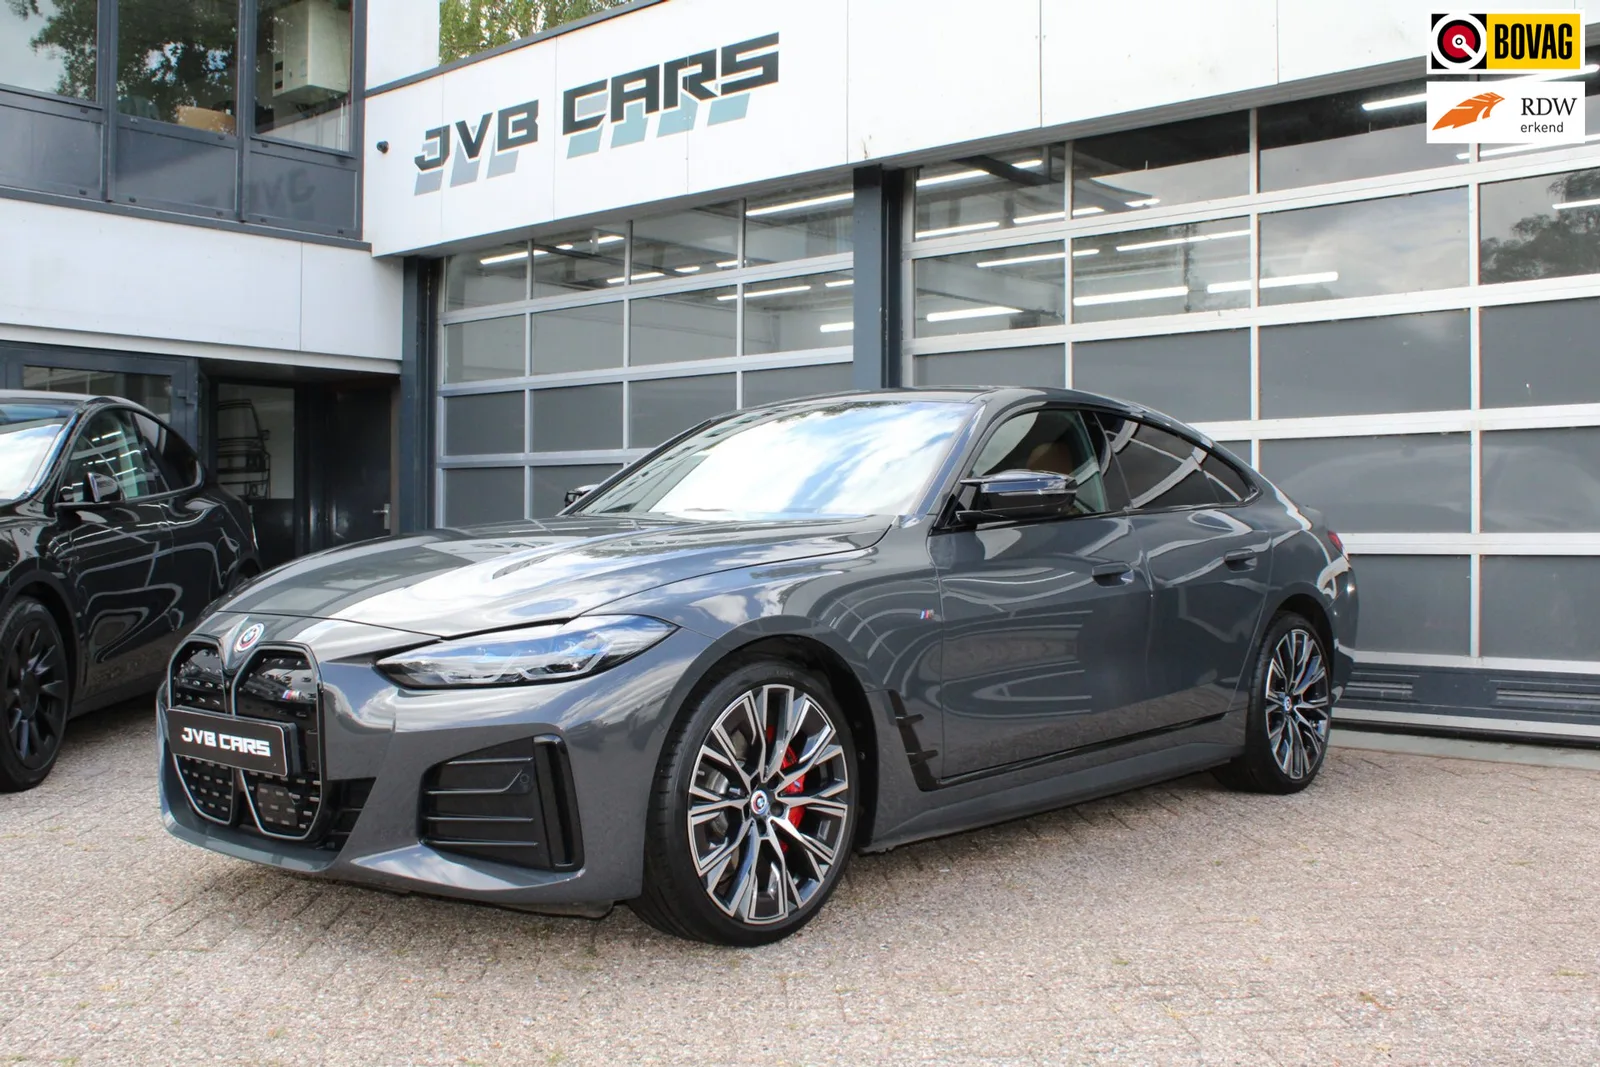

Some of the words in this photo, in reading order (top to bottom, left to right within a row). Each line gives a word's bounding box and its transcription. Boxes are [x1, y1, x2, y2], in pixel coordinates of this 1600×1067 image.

[414, 99, 539, 171] JVB
[562, 32, 779, 136] CARS
[181, 727, 217, 748] JVB
[219, 733, 271, 757] CARS
